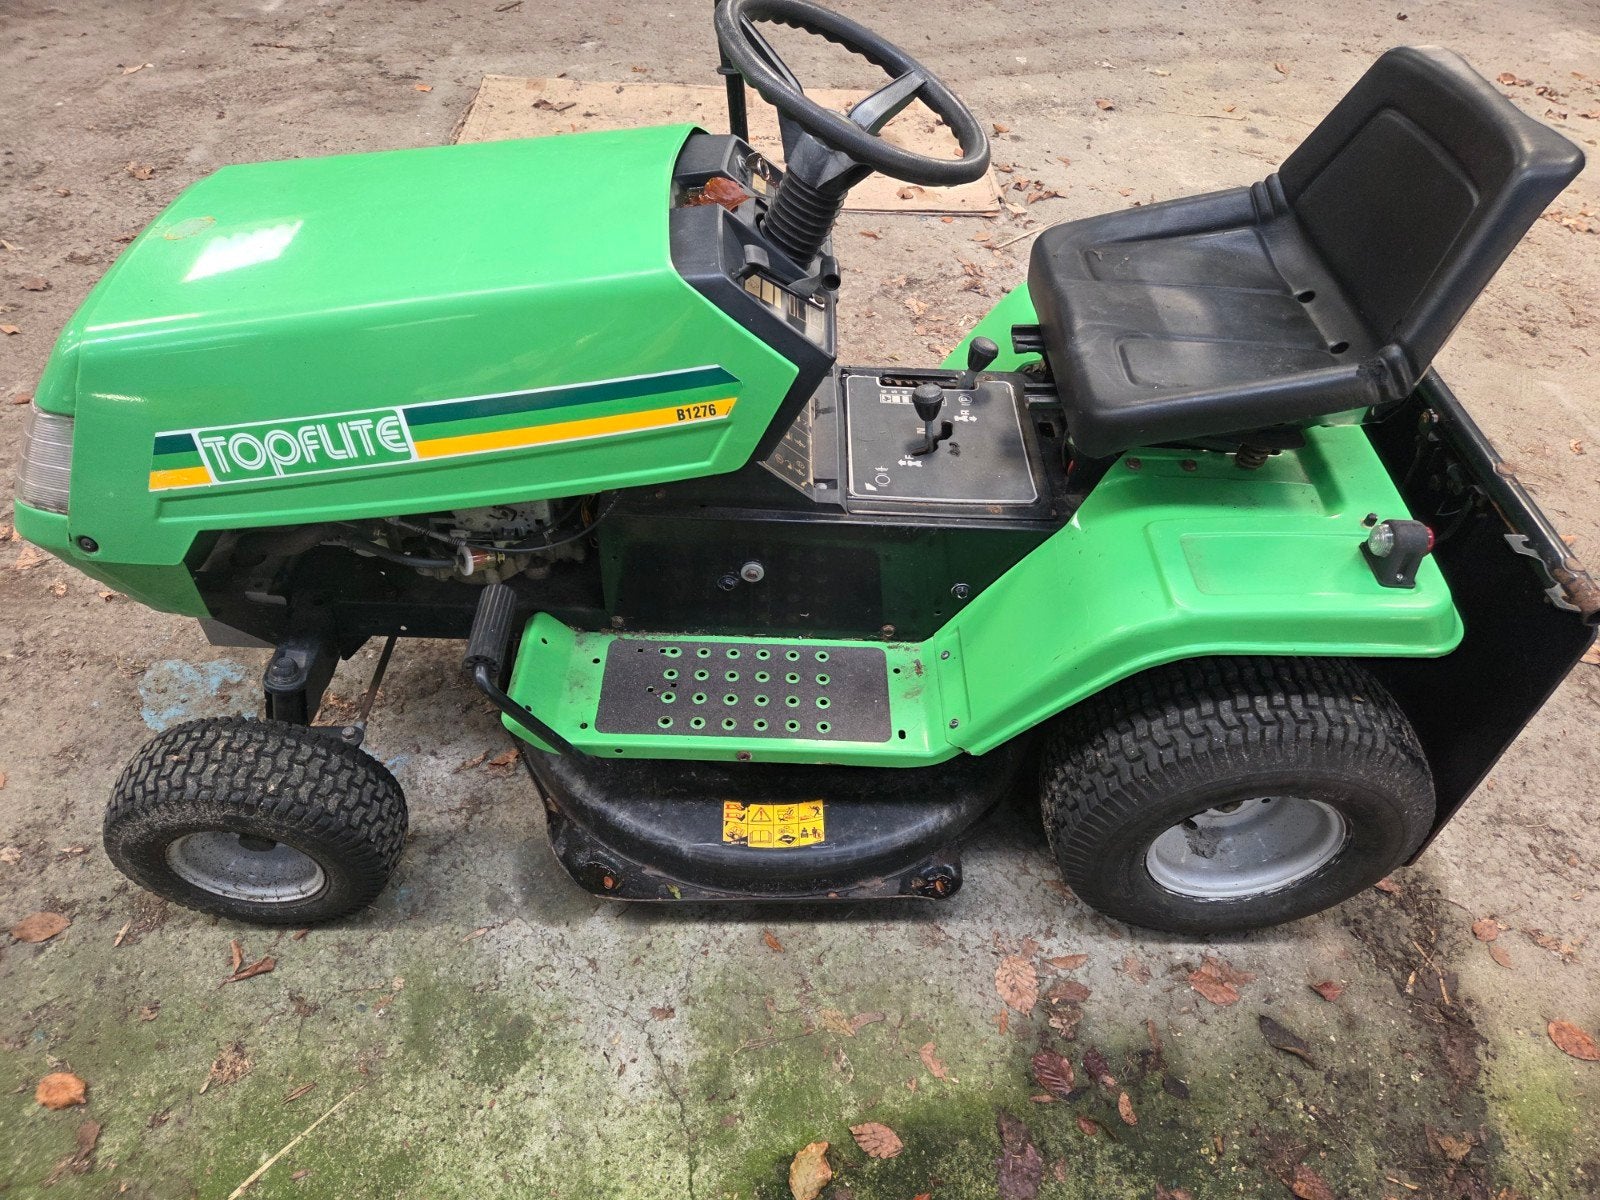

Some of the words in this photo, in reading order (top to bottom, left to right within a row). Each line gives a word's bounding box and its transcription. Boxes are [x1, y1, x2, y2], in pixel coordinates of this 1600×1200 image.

[676, 404, 717, 421] B1276
[916, 427, 926, 435] N
[200, 415, 410, 477] TOPFLITE
